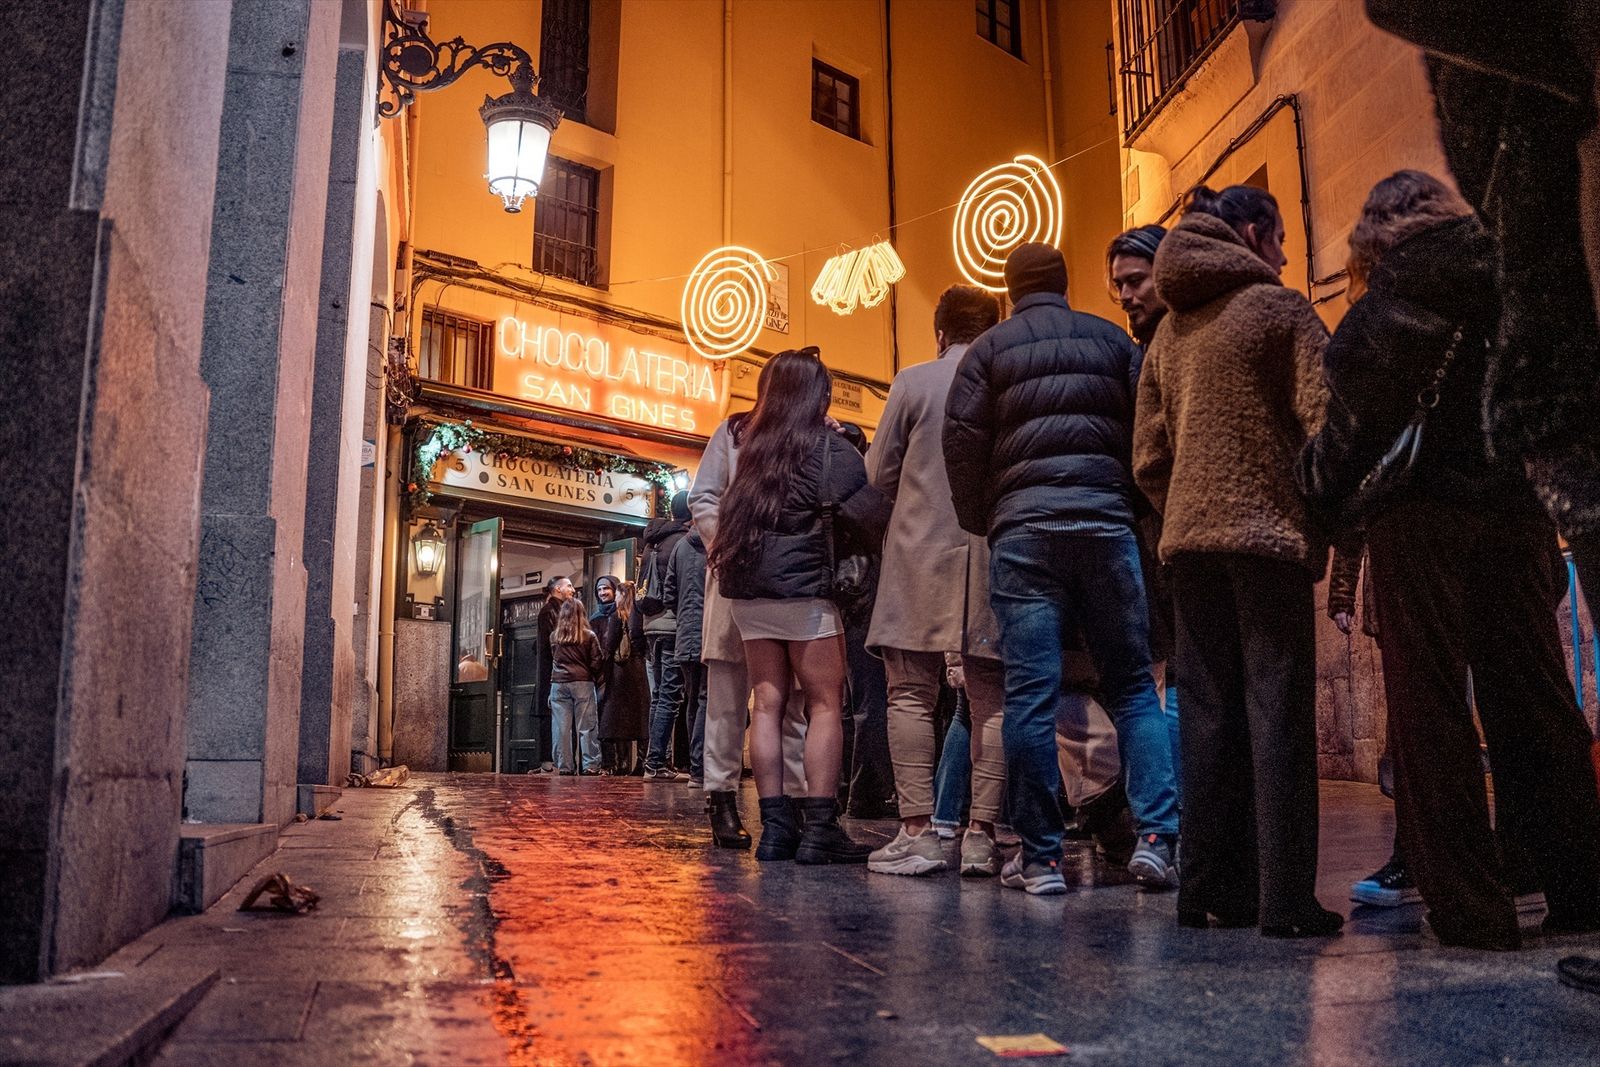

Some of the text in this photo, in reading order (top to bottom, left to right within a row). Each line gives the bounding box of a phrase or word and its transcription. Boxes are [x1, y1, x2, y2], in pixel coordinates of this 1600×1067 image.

[499, 316, 716, 402] CHOCOLATERIA
[523, 375, 696, 431] SAN GINES
[456, 458, 465, 472] 5
[480, 453, 614, 489] CHOCOLATERIA
[497, 473, 596, 502] SAN GINES
[625, 488, 635, 501] 5
